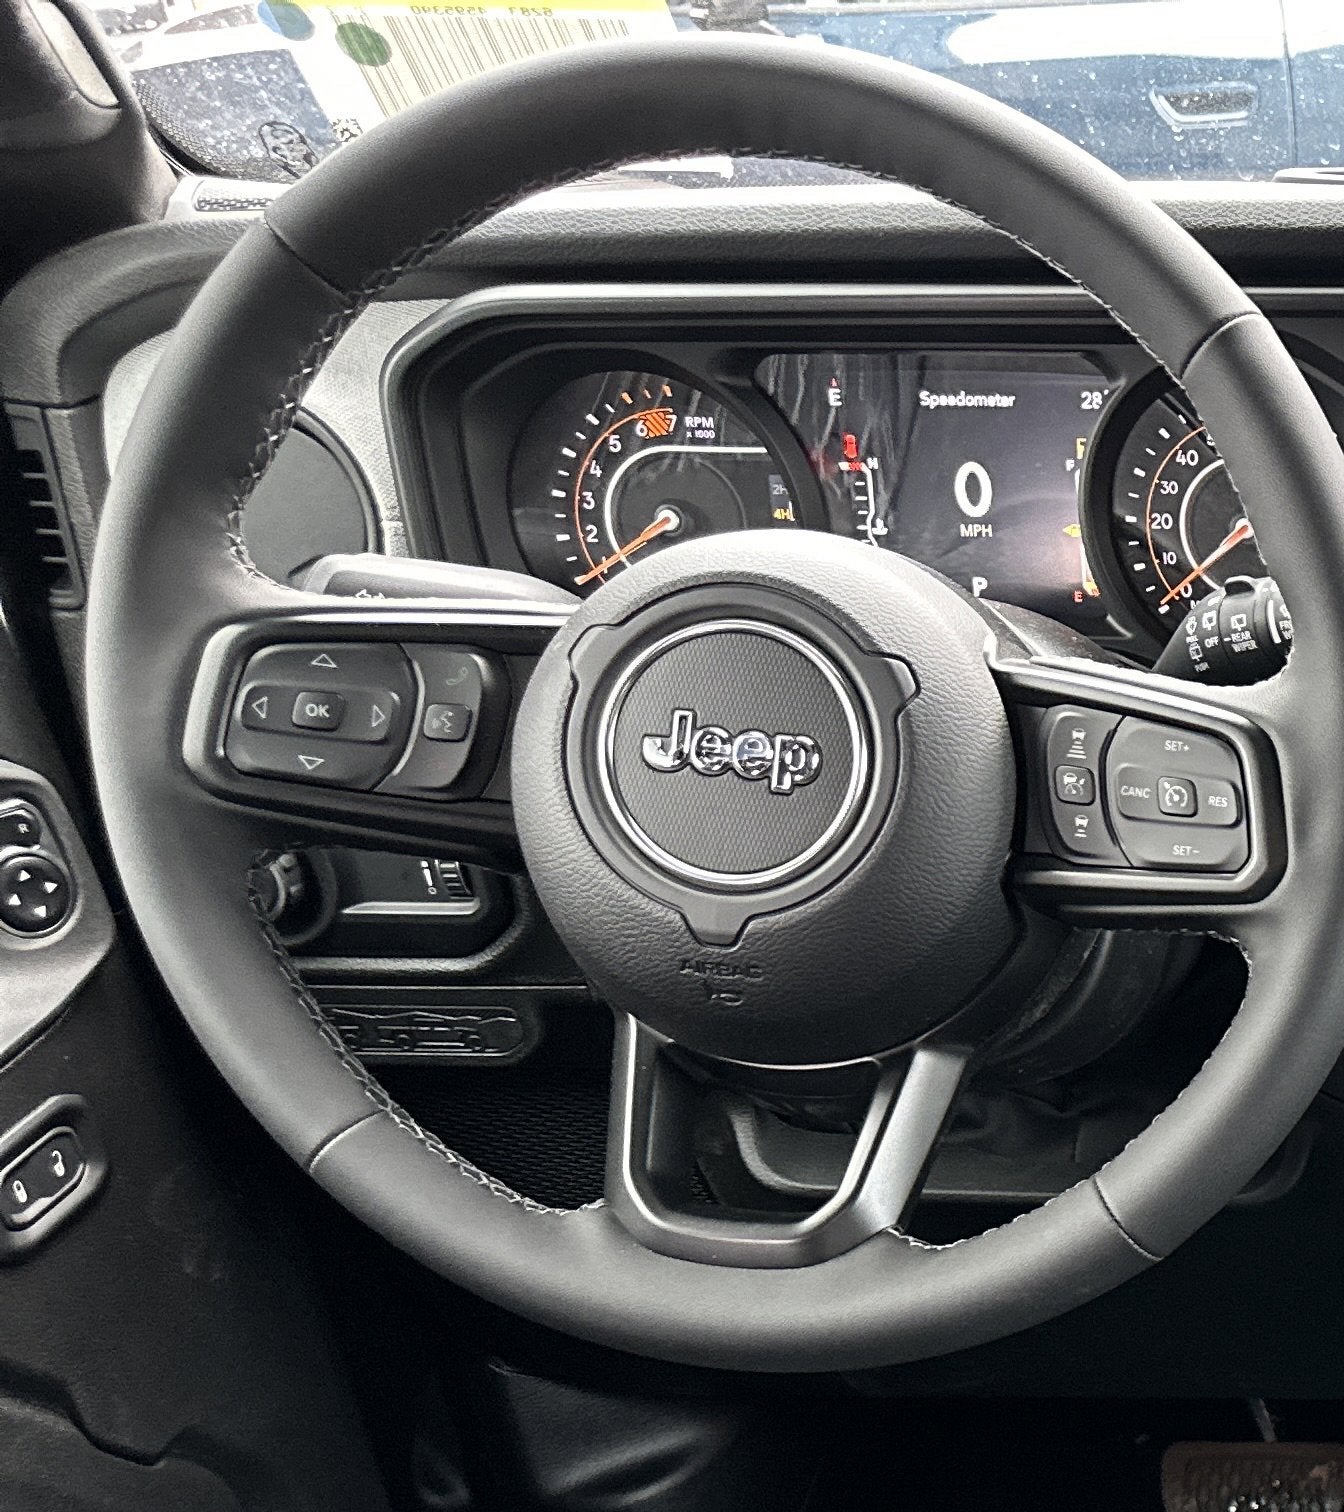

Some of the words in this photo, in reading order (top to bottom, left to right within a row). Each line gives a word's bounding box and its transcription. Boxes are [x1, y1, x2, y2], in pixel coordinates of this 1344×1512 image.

[828, 388, 843, 406] E
[919, 389, 1016, 409] Speedometer
[635, 421, 648, 437] 6
[667, 414, 678, 433] 7
[685, 416, 714, 428] RPM
[694, 430, 716, 439] 1000
[608, 435, 622, 453] 5
[1175, 449, 1199, 467] 40
[589, 459, 602, 478] 4
[954, 460, 993, 518] 0
[1160, 481, 1179, 495] 30
[582, 491, 596, 510] 3
[1151, 512, 1174, 530] 20
[585, 525, 599, 543] 2
[959, 523, 993, 537] MPH
[1162, 551, 1177, 566] 10
[972, 576, 988, 597] P
[1204, 636, 1219, 649] OFF
[1230, 630, 1252, 643] REAR
[305, 703, 331, 719] OK
[642, 708, 824, 796] Jeep
[1164, 739, 1190, 753] SET+
[1120, 785, 1151, 799] CANC
[1208, 795, 1229, 808] RES
[17, 823, 30, 834] R
[679, 958, 765, 982] AIRBAG
